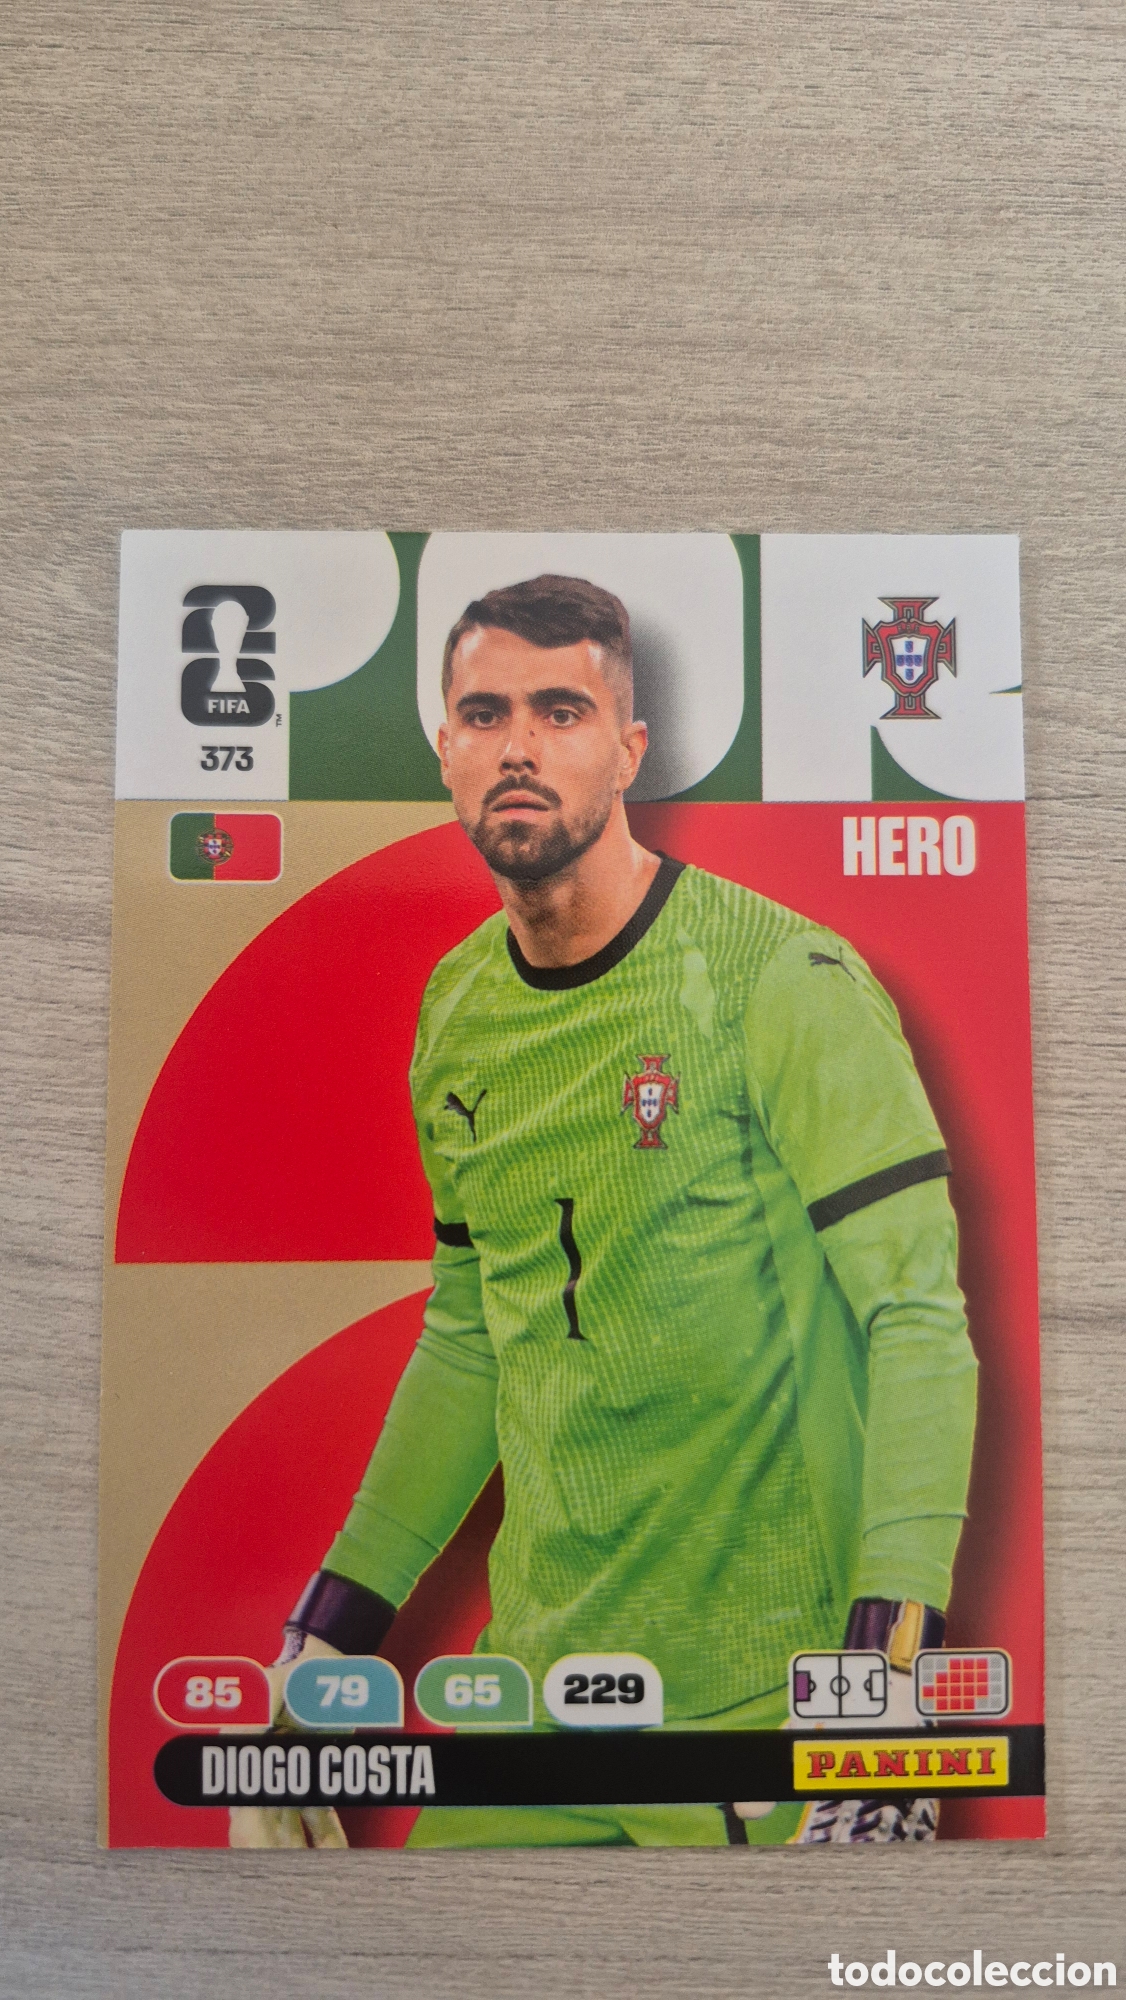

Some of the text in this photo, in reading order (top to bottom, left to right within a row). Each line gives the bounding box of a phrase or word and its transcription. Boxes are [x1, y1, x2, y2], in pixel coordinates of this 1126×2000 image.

[207, 700, 250, 714] FIFA
[276, 713, 282, 727] TM
[200, 745, 254, 771] 373
[842, 815, 976, 876] HERO
[554, 1198, 588, 1341] 1
[185, 1676, 242, 1708] 85
[316, 1674, 369, 1706] 79
[444, 1674, 501, 1706] 65
[563, 1673, 646, 1705] 229
[201, 1745, 436, 1795] DIOGO COSTA
[807, 1748, 996, 1778] PANINI
